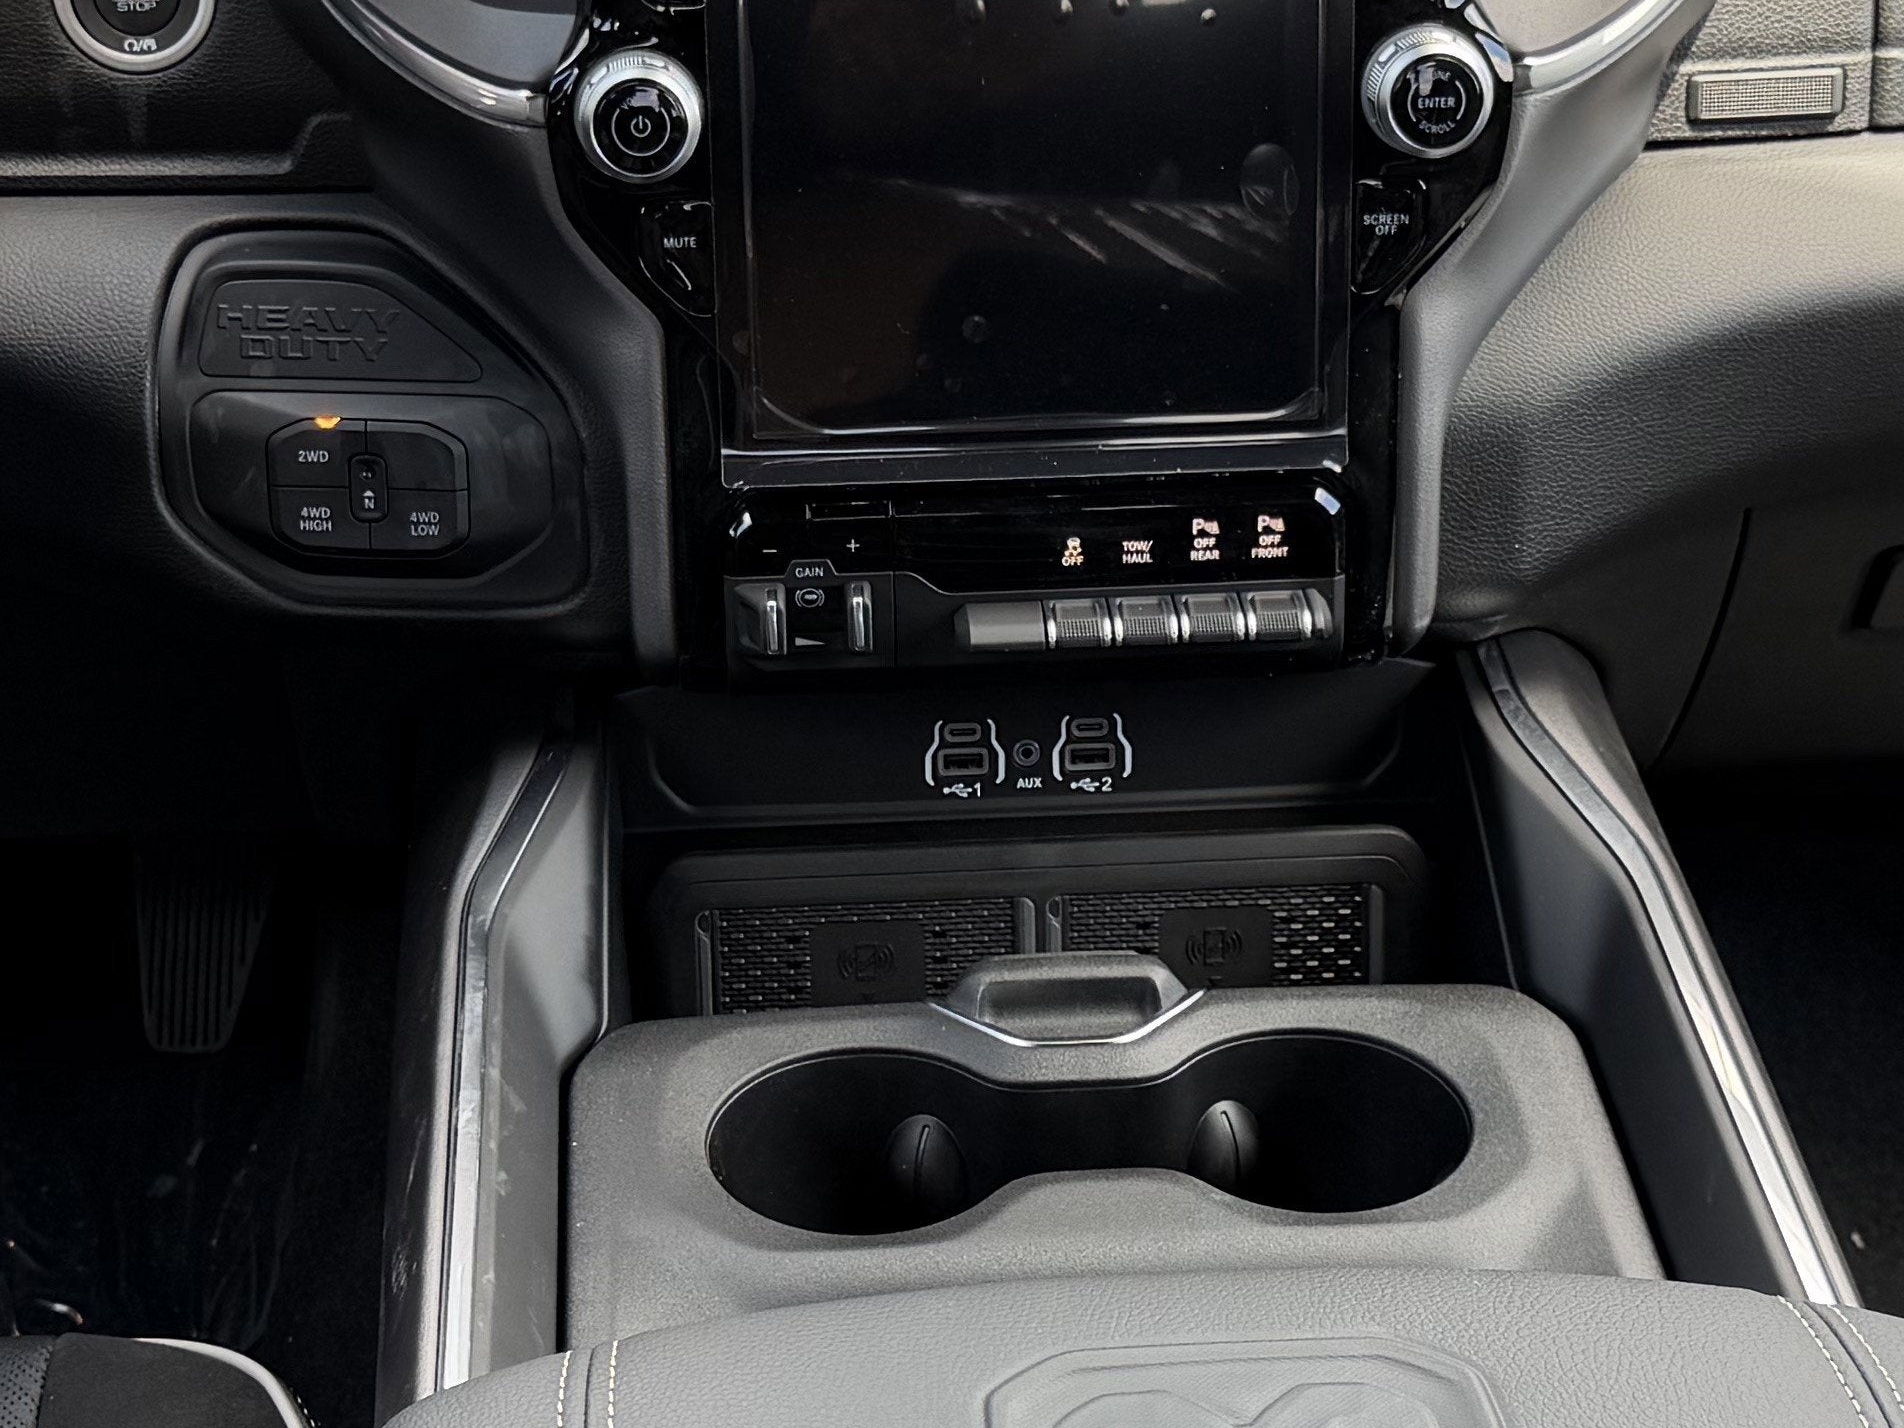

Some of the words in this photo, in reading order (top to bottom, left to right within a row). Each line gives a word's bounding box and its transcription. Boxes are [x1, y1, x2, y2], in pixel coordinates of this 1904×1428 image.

[116, 0, 156, 12] STOP
[1417, 97, 1456, 110] ENTER
[1417, 120, 1456, 135] SCROLL
[1363, 214, 1410, 227] SCREEN
[1375, 224, 1398, 236] OFF
[663, 236, 697, 249] MUTE
[216, 304, 400, 334] HEAVY
[240, 334, 389, 363] DUTY
[298, 450, 329, 463] 2WD
[364, 498, 375, 509] N
[300, 506, 331, 519] 4WD
[409, 511, 440, 523] 4WD
[299, 519, 332, 532] HIGH
[410, 523, 440, 536] LOW
[1122, 540, 1153, 553] TOW/
[1193, 537, 1217, 549] OFF
[1258, 534, 1281, 547] OFF
[1122, 552, 1153, 564] HAUL
[1190, 548, 1220, 561] REAR
[1251, 546, 1289, 559] FRONT
[1061, 555, 1084, 567] OFF
[795, 566, 824, 578] GAIN
[1016, 777, 1043, 789] AUX
[1100, 777, 1113, 792] 2
